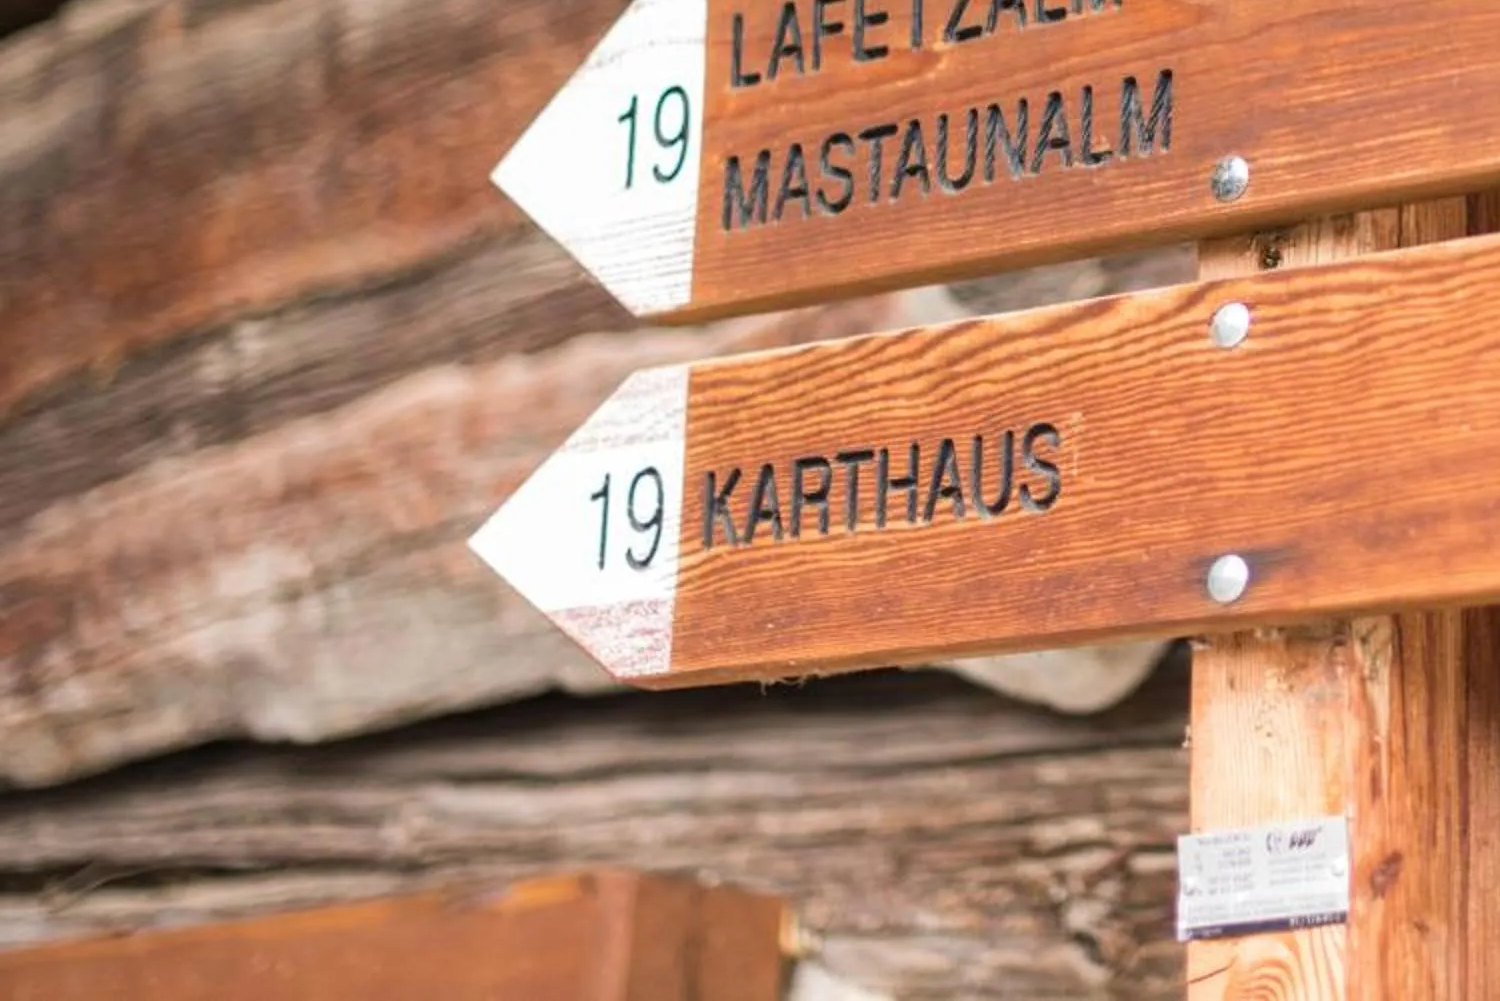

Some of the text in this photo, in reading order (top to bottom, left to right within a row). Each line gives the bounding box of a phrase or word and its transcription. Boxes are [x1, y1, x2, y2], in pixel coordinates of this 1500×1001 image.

[617, 84, 692, 191] 19
[720, 68, 1173, 232] MASTAUNALM
[589, 466, 666, 571] 19
[701, 421, 1063, 551] KARTHAUS
